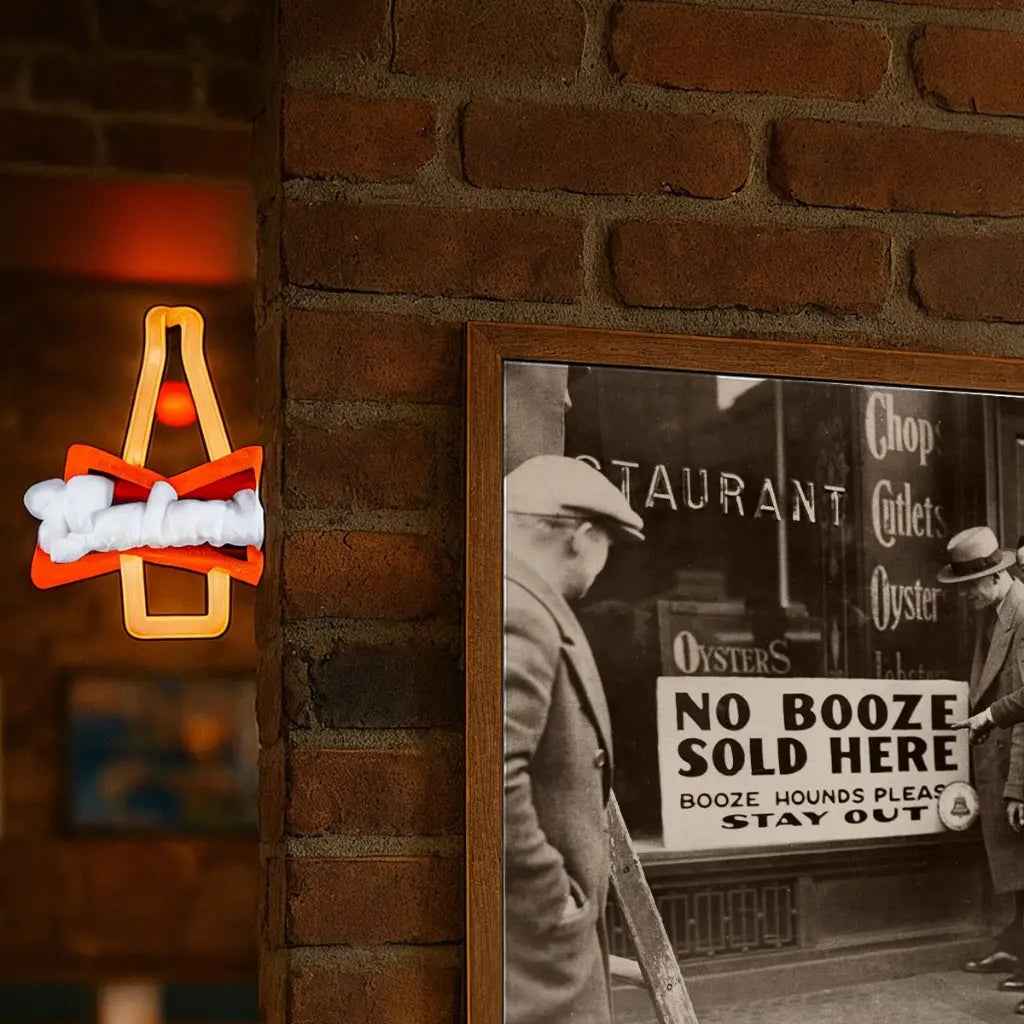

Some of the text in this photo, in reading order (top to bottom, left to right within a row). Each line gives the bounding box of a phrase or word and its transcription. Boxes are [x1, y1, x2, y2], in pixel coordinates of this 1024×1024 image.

[674, 692, 958, 731] NO BOOZE
[677, 735, 959, 777] SOLD HERE
[680, 791, 760, 809] BOOZE
[775, 787, 865, 806] HOUNDS
[721, 806, 929, 829] STAY OUT
